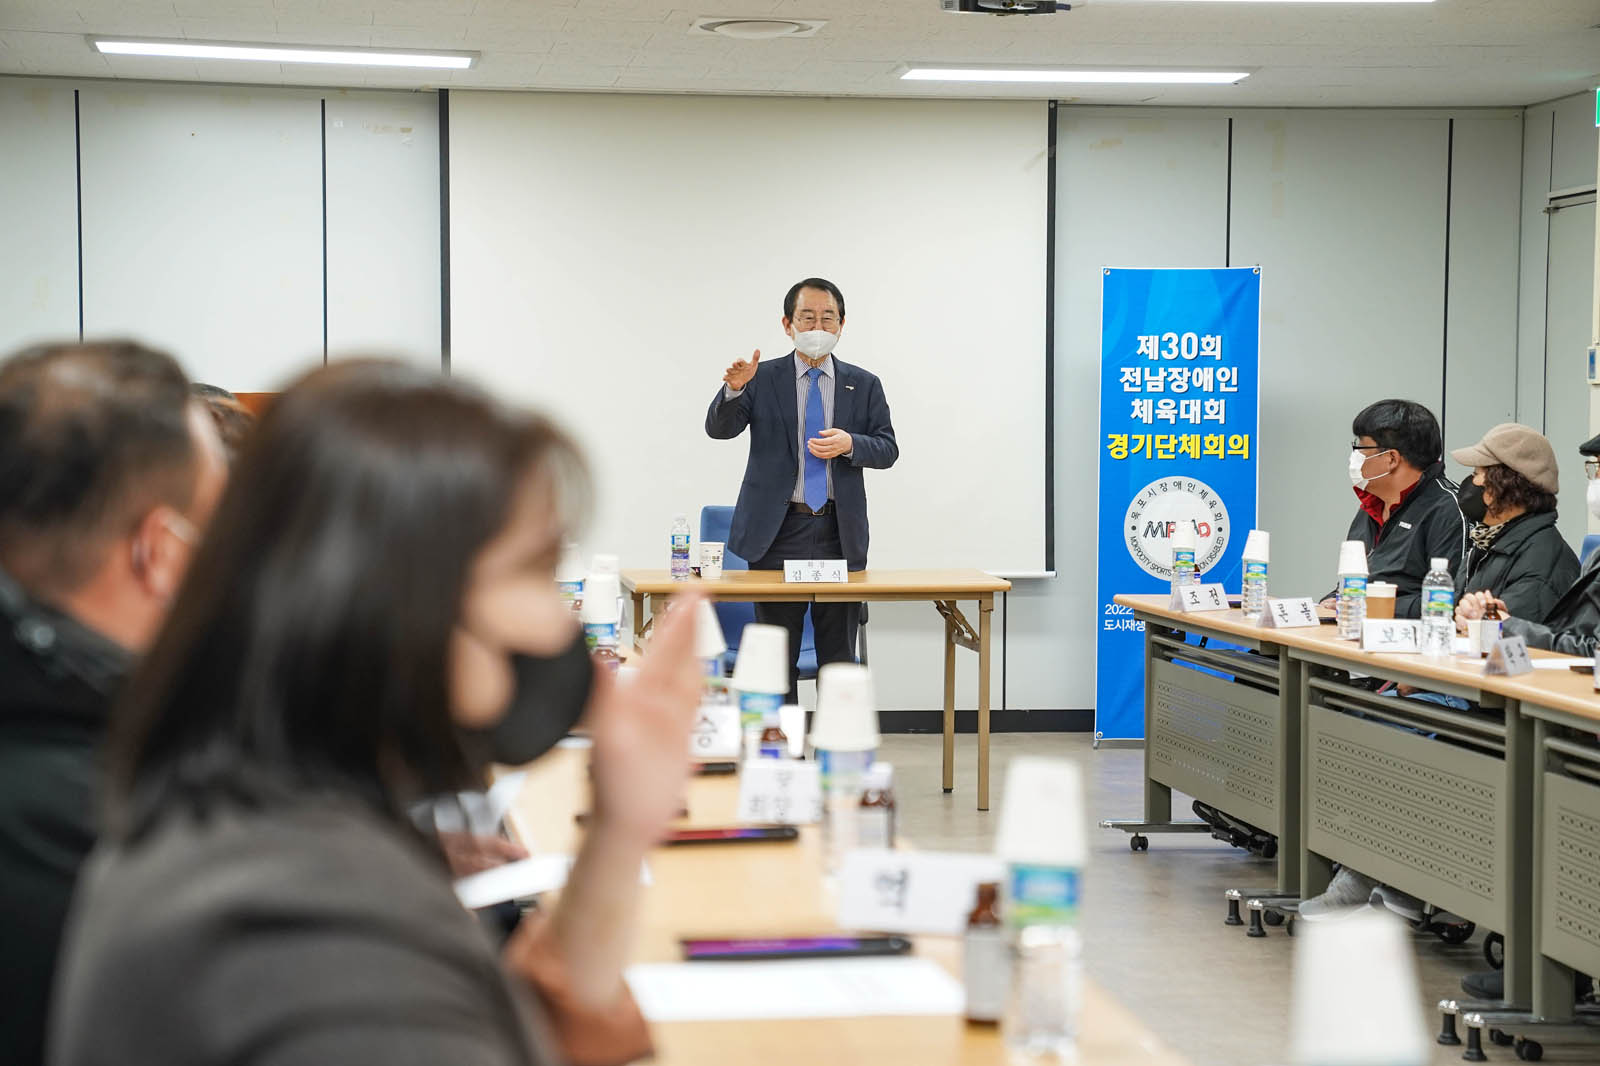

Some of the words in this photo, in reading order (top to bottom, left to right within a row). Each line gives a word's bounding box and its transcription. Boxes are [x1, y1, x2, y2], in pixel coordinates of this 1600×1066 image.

[1136, 332, 1222, 361] 제30회
[1119, 367, 1238, 393] 전남장애인
[1130, 399, 1226, 425] 체육대회
[1106, 433, 1250, 460] 경기단체회의
